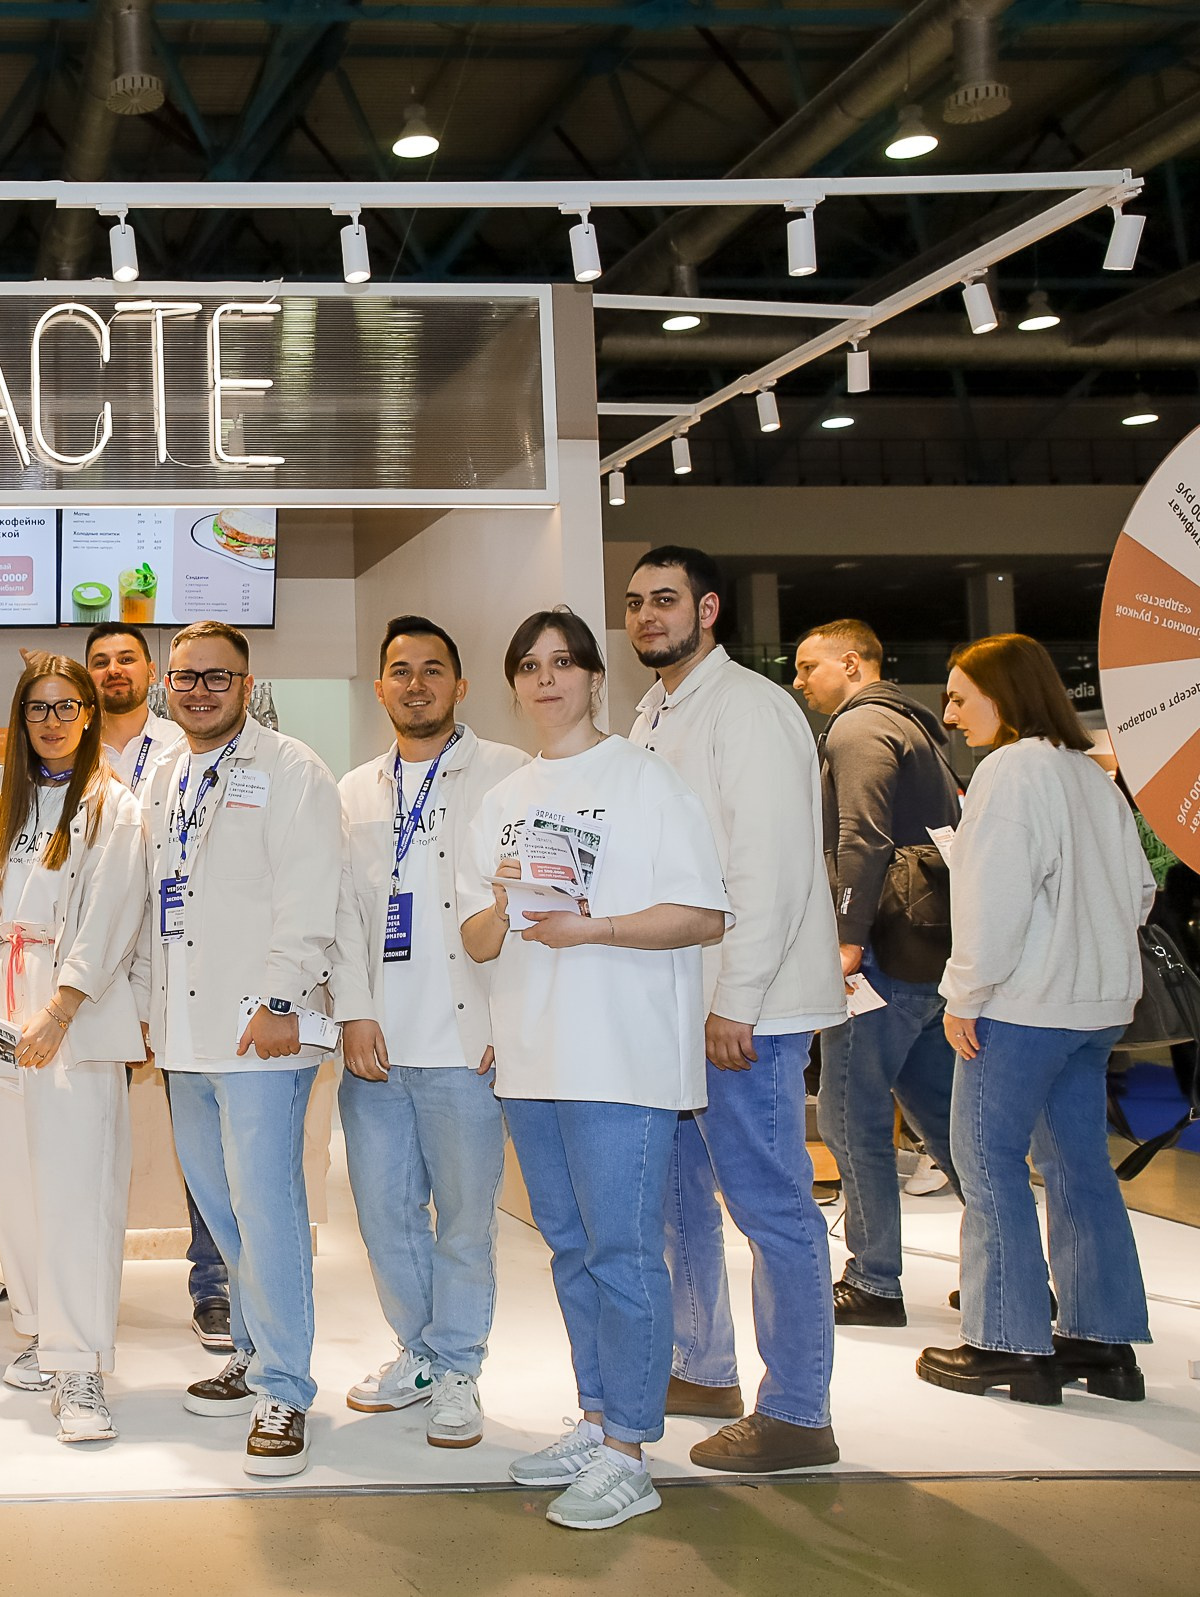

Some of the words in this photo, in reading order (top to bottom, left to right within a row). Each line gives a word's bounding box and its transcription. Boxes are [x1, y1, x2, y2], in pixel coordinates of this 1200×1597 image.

[1175, 482, 1195, 504] руб
[0, 517, 46, 528] кофейню
[1116, 604, 1151, 622] ручкой
[1135, 593, 1192, 615] «здрасте»
[1153, 616, 1159, 625] с
[1160, 702, 1166, 711] в
[1117, 707, 1158, 733] подарок
[536, 809, 566, 823] ЗДРАСТЕ
[1177, 798, 1192, 826] руб
